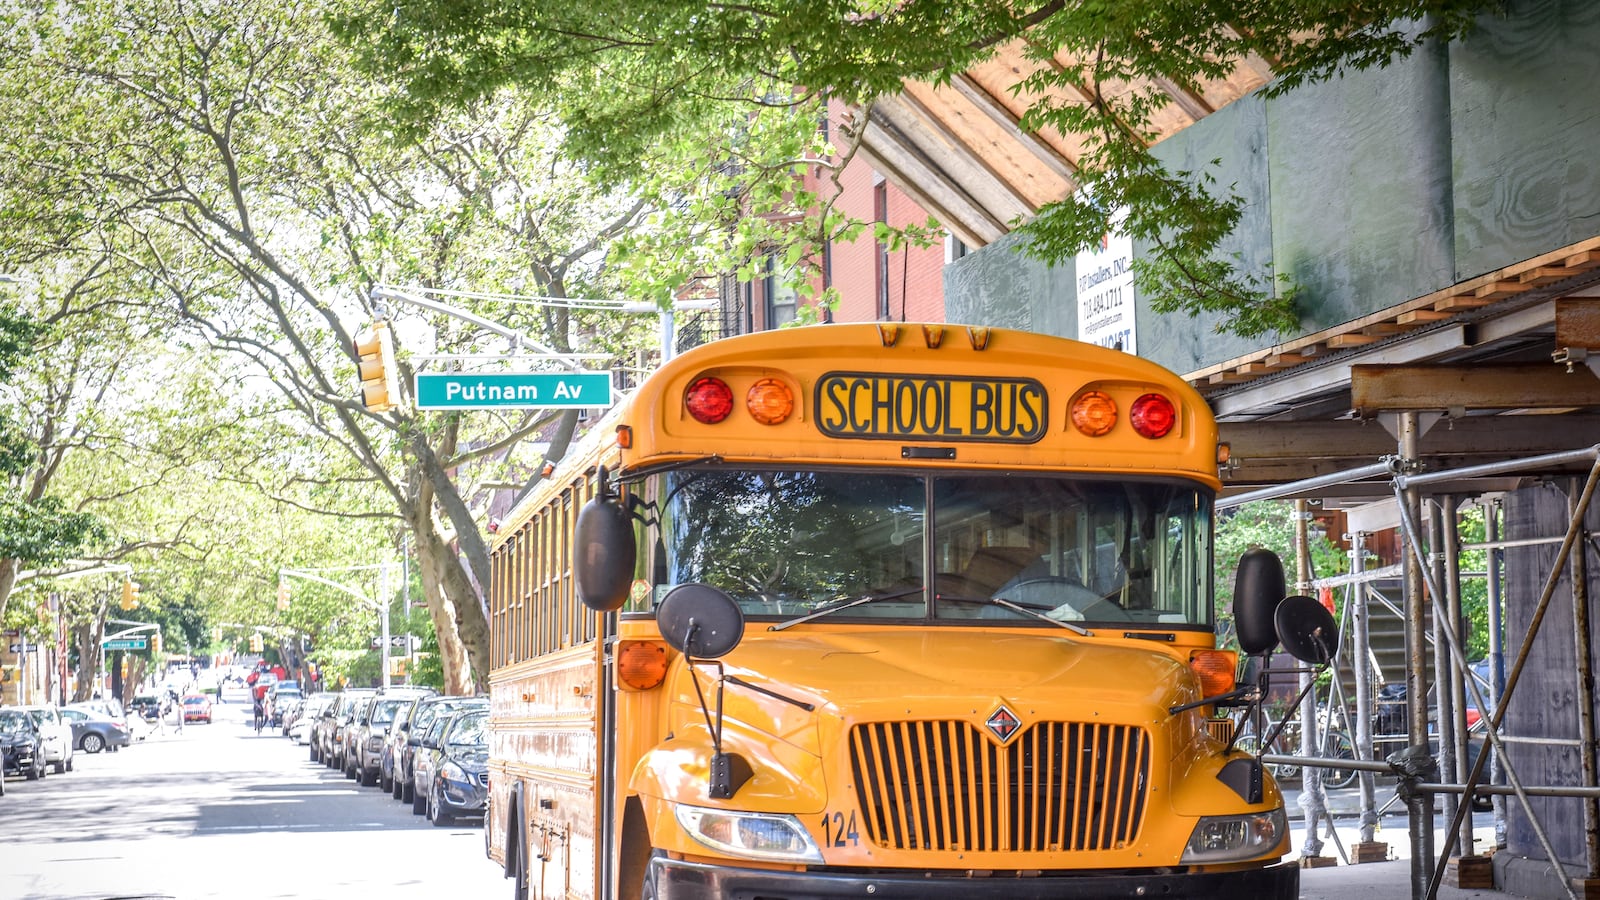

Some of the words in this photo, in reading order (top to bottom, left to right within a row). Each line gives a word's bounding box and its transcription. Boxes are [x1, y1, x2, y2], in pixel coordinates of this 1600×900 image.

[446, 382, 537, 400] Putnam
[553, 381, 583, 399] Av
[826, 378, 962, 435] SCHOOL
[970, 382, 1040, 437] BUS
[821, 809, 859, 848] 124
